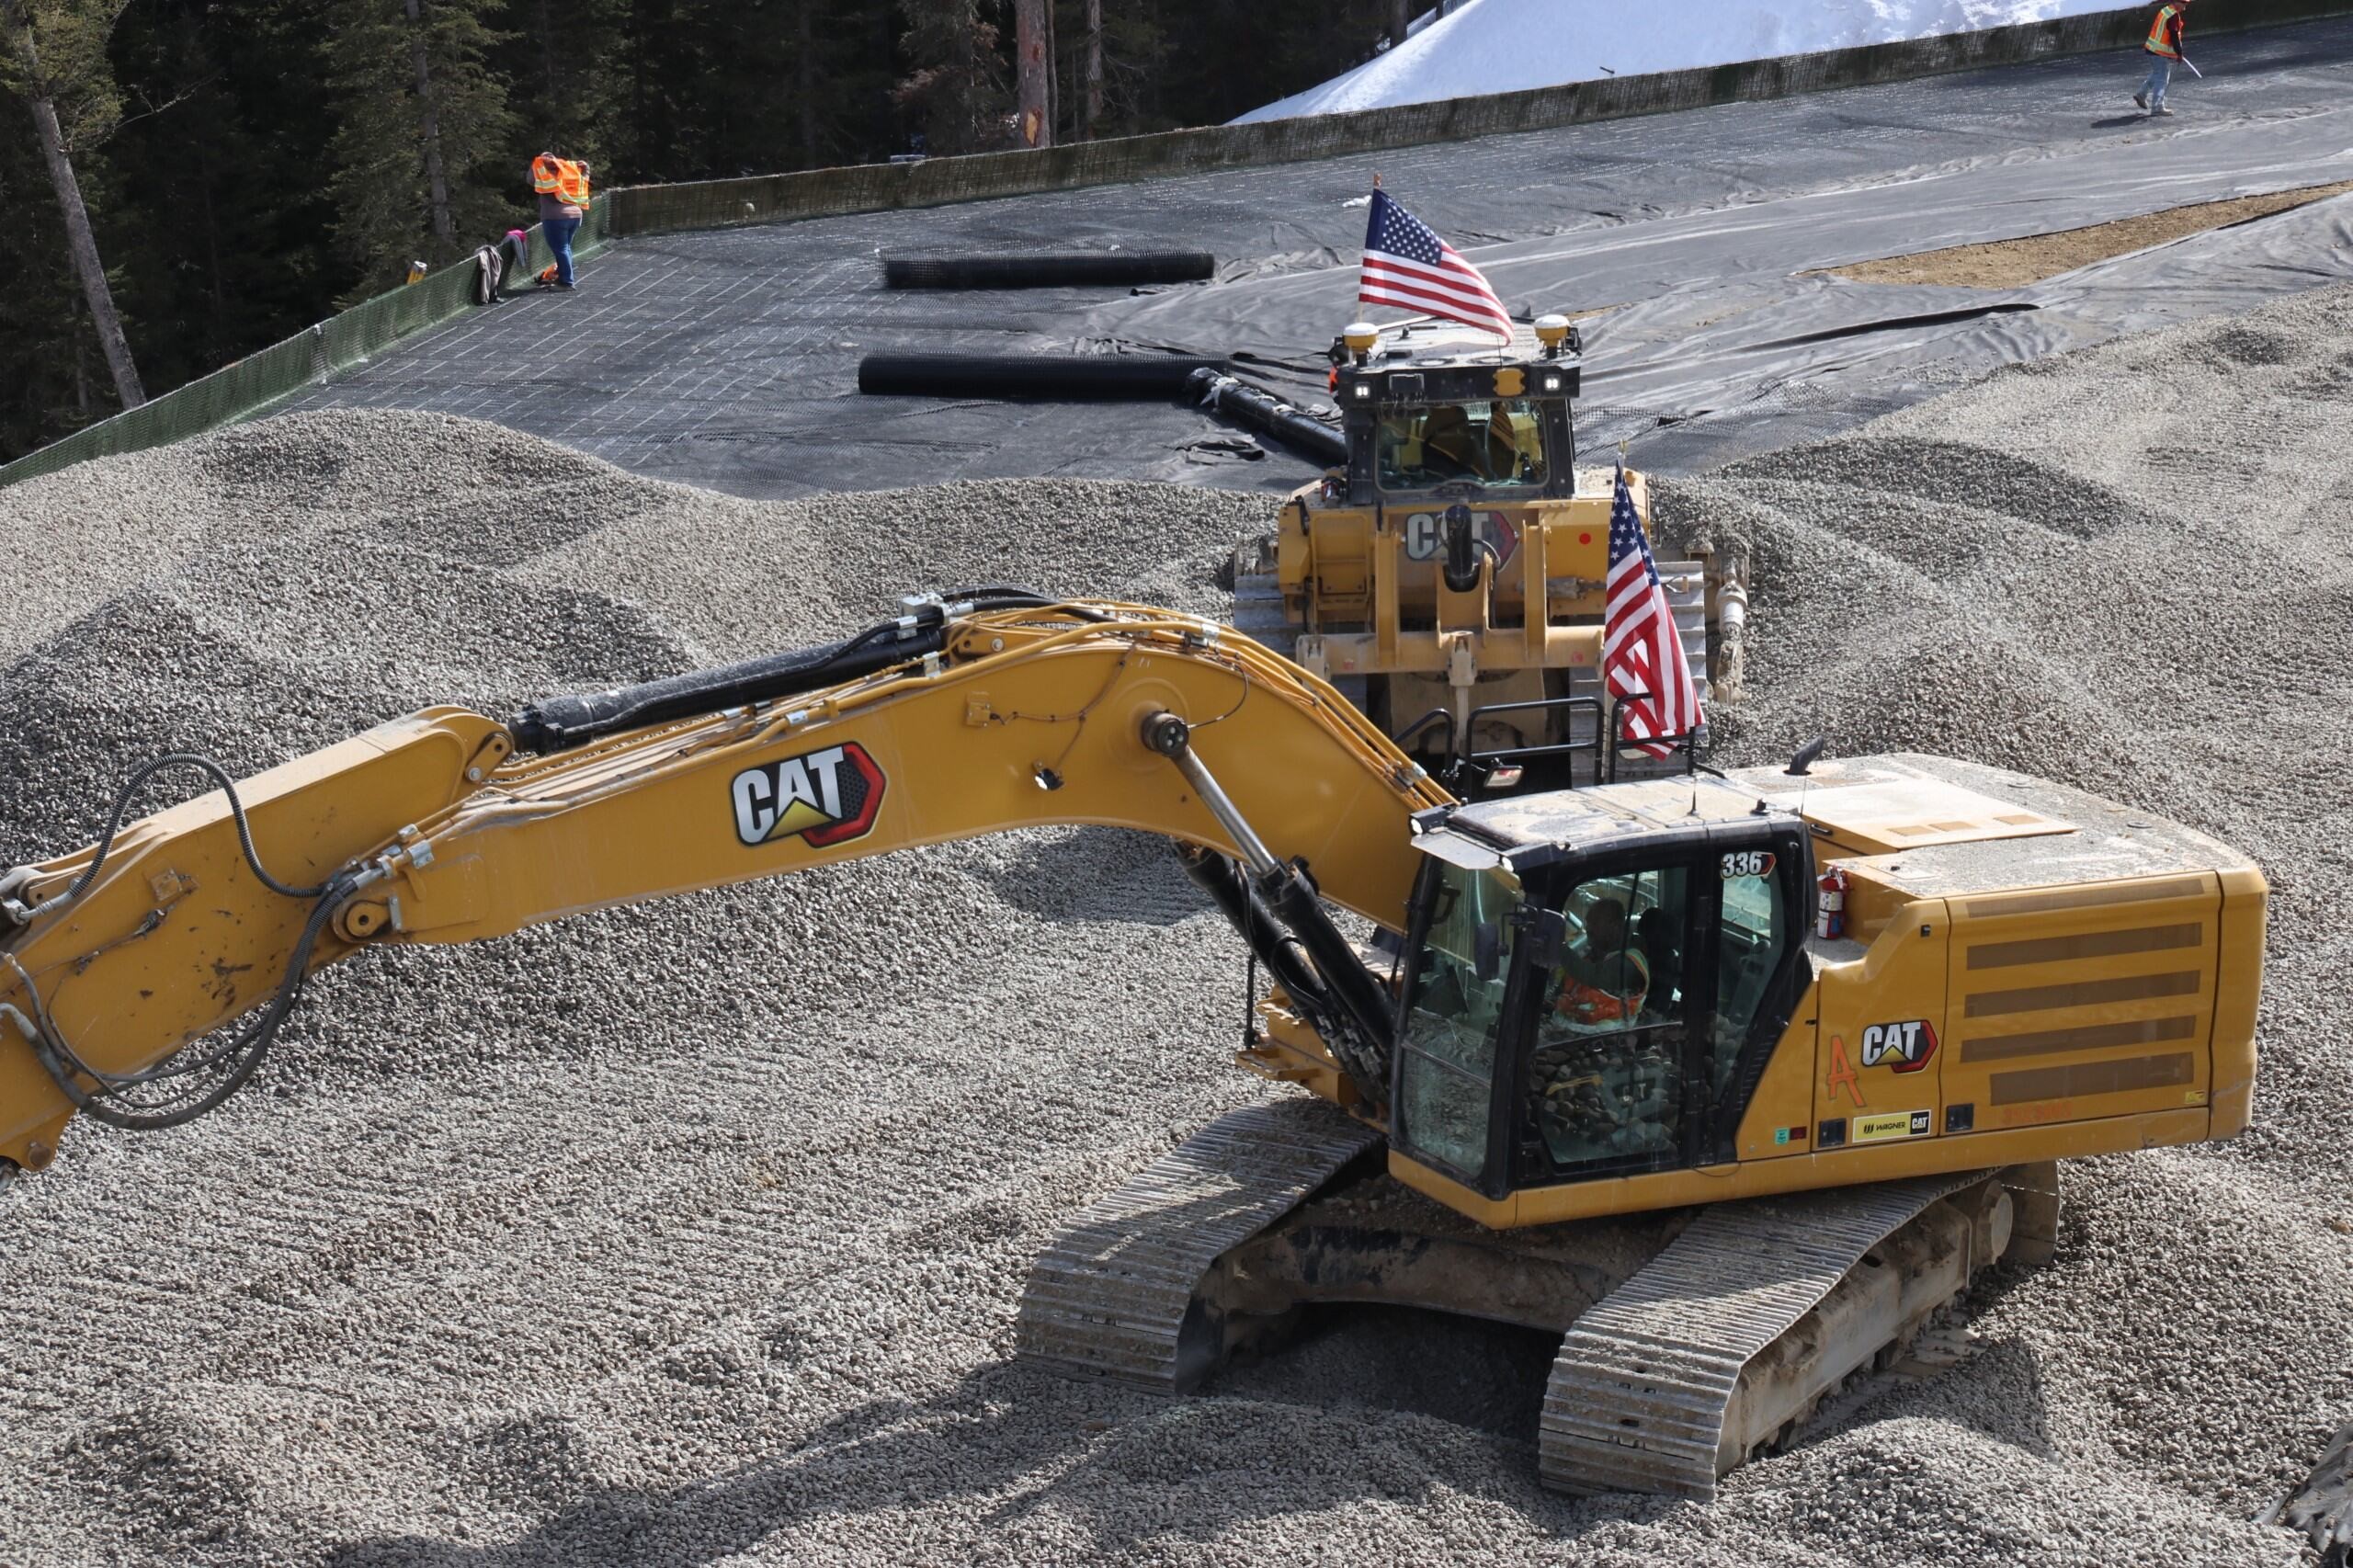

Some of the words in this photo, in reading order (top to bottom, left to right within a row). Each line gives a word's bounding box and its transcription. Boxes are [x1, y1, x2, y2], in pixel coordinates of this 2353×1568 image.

[733, 746, 844, 843] CAT
[1722, 852, 1762, 877] 336
[1862, 1021, 1921, 1065] CAT
[1826, 1035, 1866, 1107] A
[1876, 1121, 1905, 1131] WAGNER
[1912, 1117, 1927, 1129] CAT
